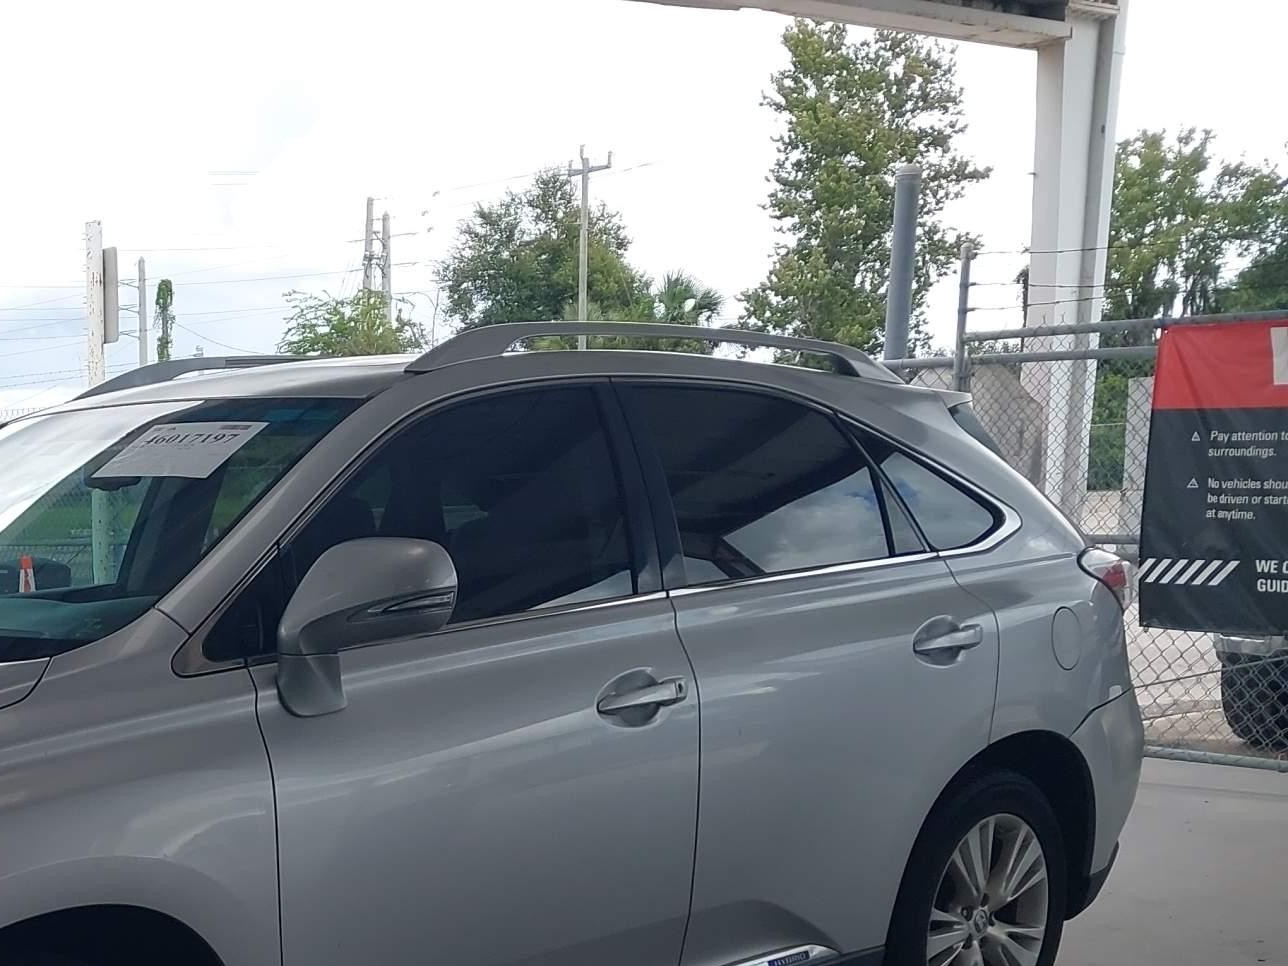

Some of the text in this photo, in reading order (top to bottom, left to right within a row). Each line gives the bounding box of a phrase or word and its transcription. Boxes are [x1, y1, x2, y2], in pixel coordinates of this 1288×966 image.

[143, 433, 241, 445] 46017197
[1211, 431, 1230, 443] Pay
[1231, 430, 1278, 441] attention
[1208, 445, 1277, 459] surroundings.
[1208, 477, 1220, 489] No
[1221, 478, 1262, 489] vehicles
[1208, 493, 1288, 505] be driven or start
[1206, 509, 1256, 521] at anytime.
[1256, 559, 1279, 573] WE
[1257, 578, 1288, 593] GUID
